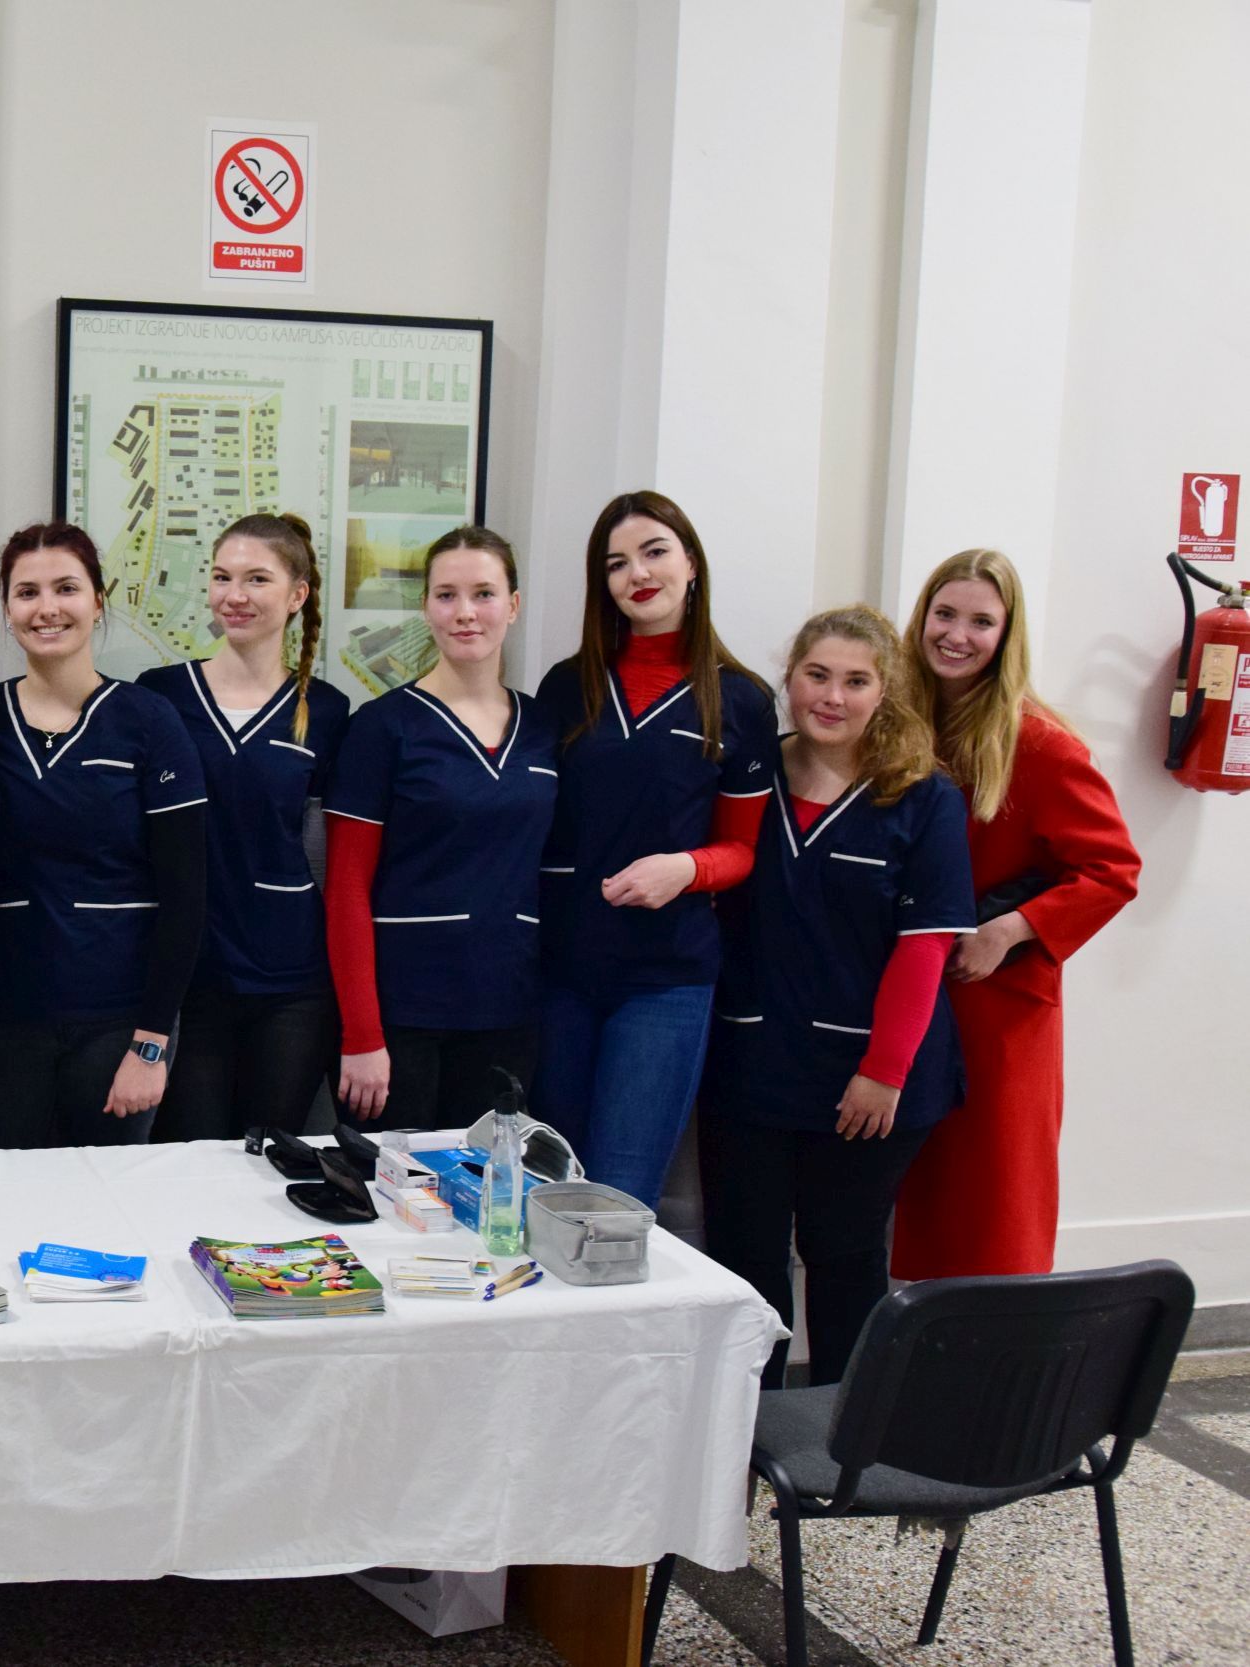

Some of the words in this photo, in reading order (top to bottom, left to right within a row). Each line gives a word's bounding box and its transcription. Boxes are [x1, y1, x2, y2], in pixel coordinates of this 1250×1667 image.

[222, 246, 294, 258] ZABRANJENO
[240, 258, 276, 269] PUŠITI
[75, 316, 132, 335] PROJEKT
[135, 320, 210, 339] IZGRADNJE
[214, 324, 268, 342] NOVOG
[271, 327, 334, 345] KAMPUSA
[337, 329, 414, 349] SVEUČILIŠTA
[417, 335, 426, 350] U
[430, 335, 475, 352] ZADRU
